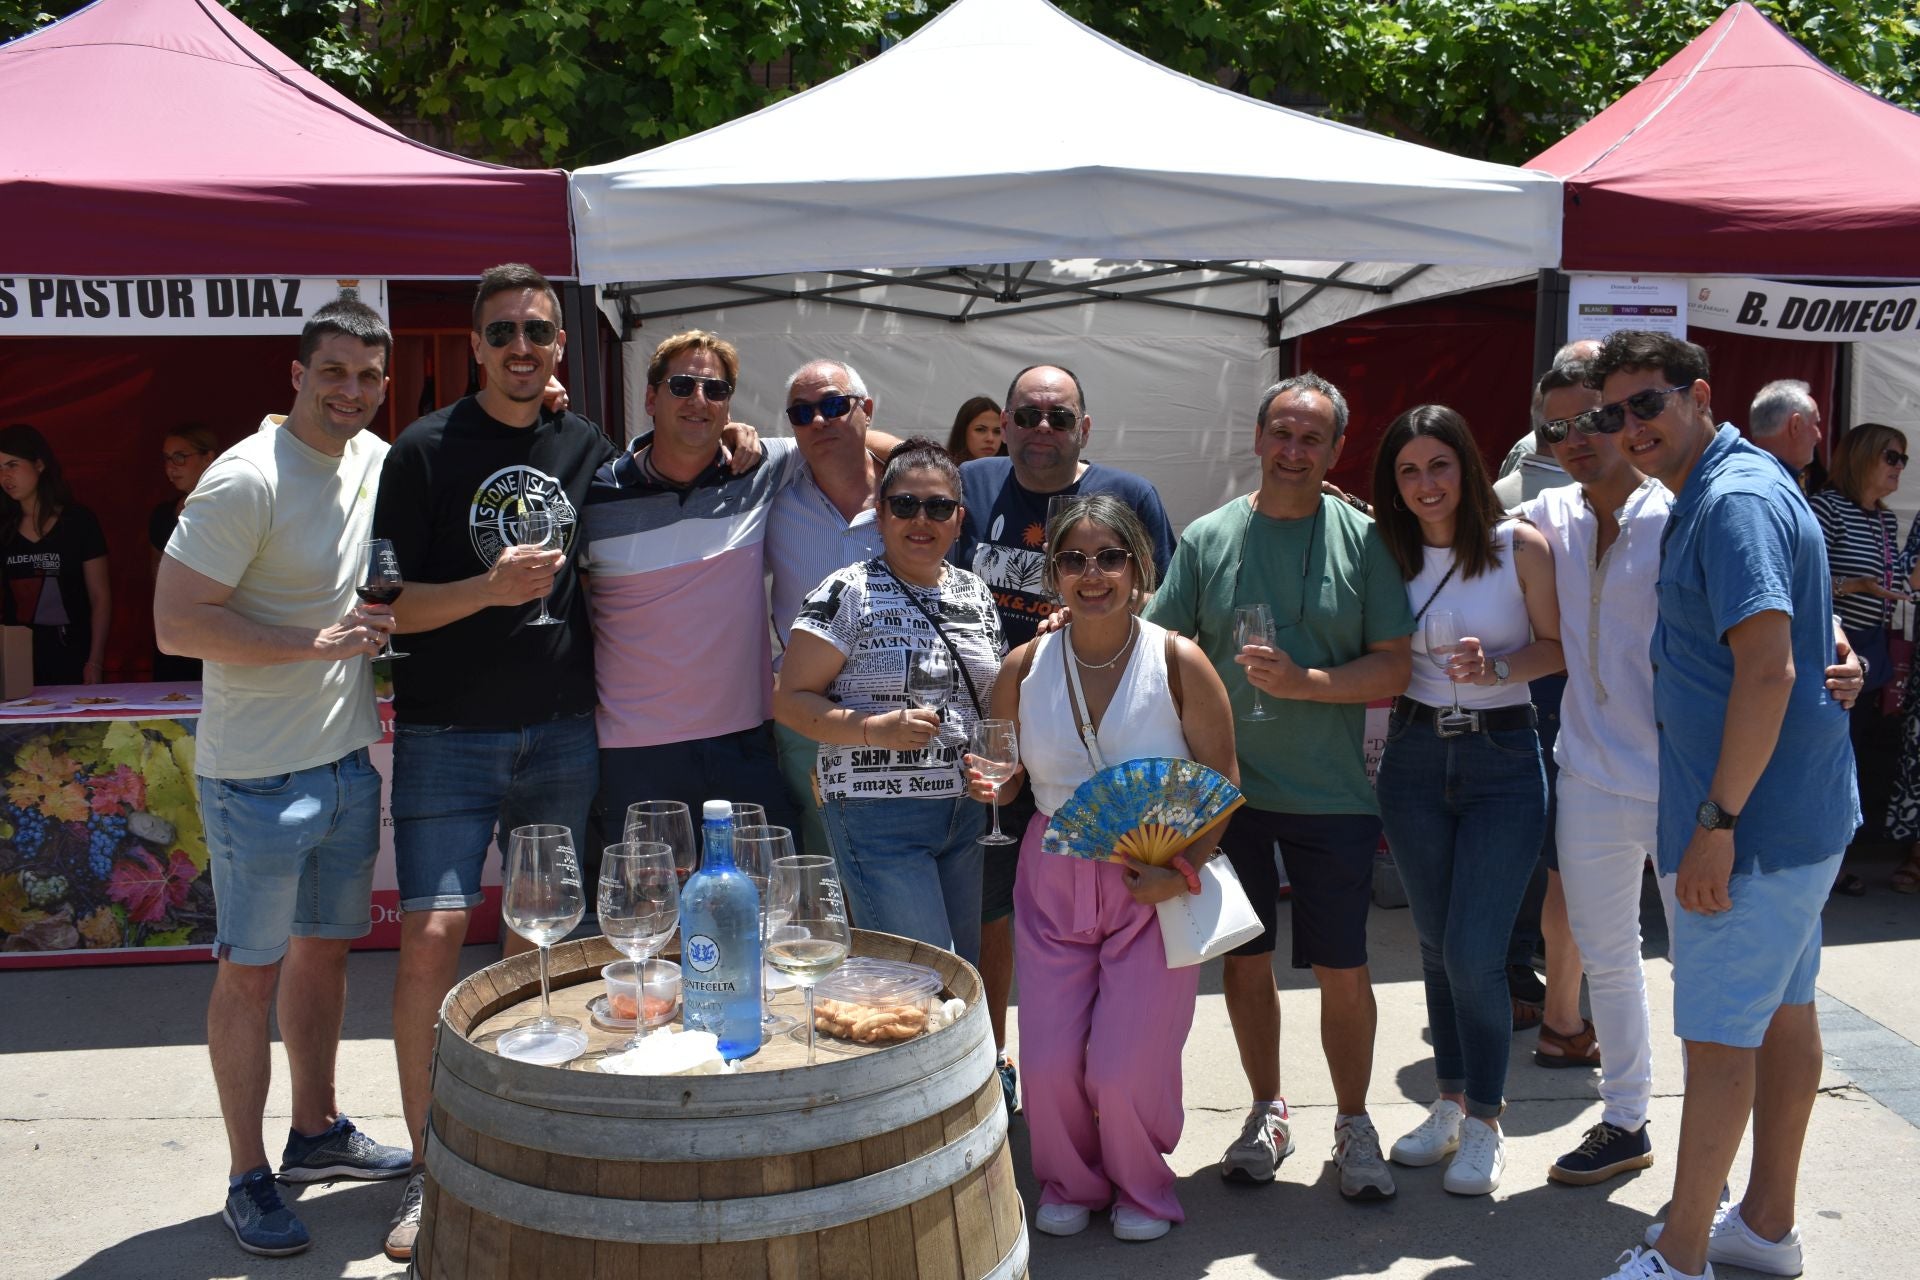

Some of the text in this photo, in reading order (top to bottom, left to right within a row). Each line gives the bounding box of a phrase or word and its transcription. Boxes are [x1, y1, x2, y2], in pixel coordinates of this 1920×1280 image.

[28, 279, 195, 318] PASTOR
[205, 279, 303, 317] DIAZ
[1736, 291, 1769, 327] B.
[1776, 297, 1917, 332] DOMECO
[480, 475, 517, 518] STONE
[7, 553, 60, 565] ALDEANUEVA
[951, 584, 975, 594] FUNNY
[851, 750, 891, 767] NEWS
[908, 776, 954, 793] News
